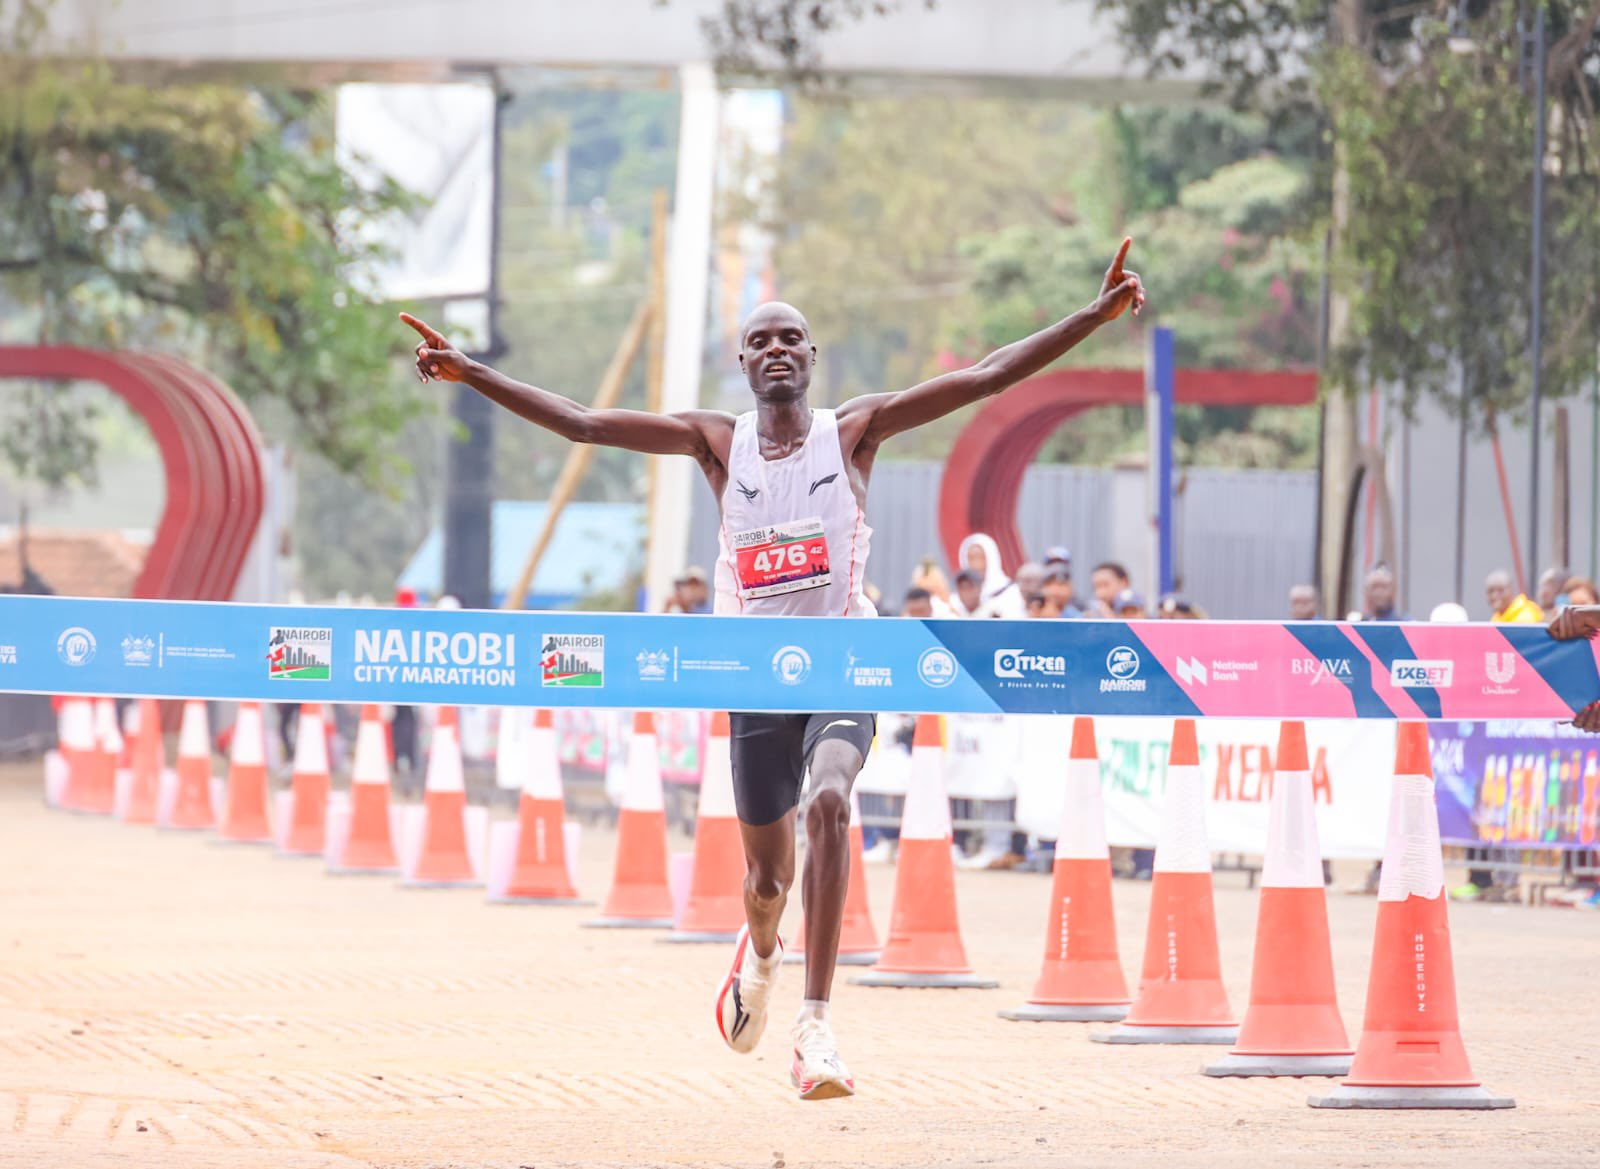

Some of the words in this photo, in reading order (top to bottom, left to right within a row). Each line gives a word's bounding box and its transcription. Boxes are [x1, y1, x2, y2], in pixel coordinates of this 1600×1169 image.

[734, 530, 766, 543] AIROBI
[810, 546, 823, 554] 42
[753, 544, 808, 573] 476
[283, 629, 331, 641] NAIROBI
[555, 636, 603, 647] NAIROBI
[354, 629, 515, 667] NAIROBI
[0, 655, 17, 664] YA
[1212, 660, 1258, 670] National
[354, 665, 399, 683] CITY
[402, 667, 515, 686] MARATHON
[1212, 671, 1239, 681] Bank
[1291, 658, 1352, 686] BRAVA
[1396, 667, 1448, 680] 1XBET
[854, 676, 893, 686] KENYA
[1101, 679, 1146, 688] NAIROBI
